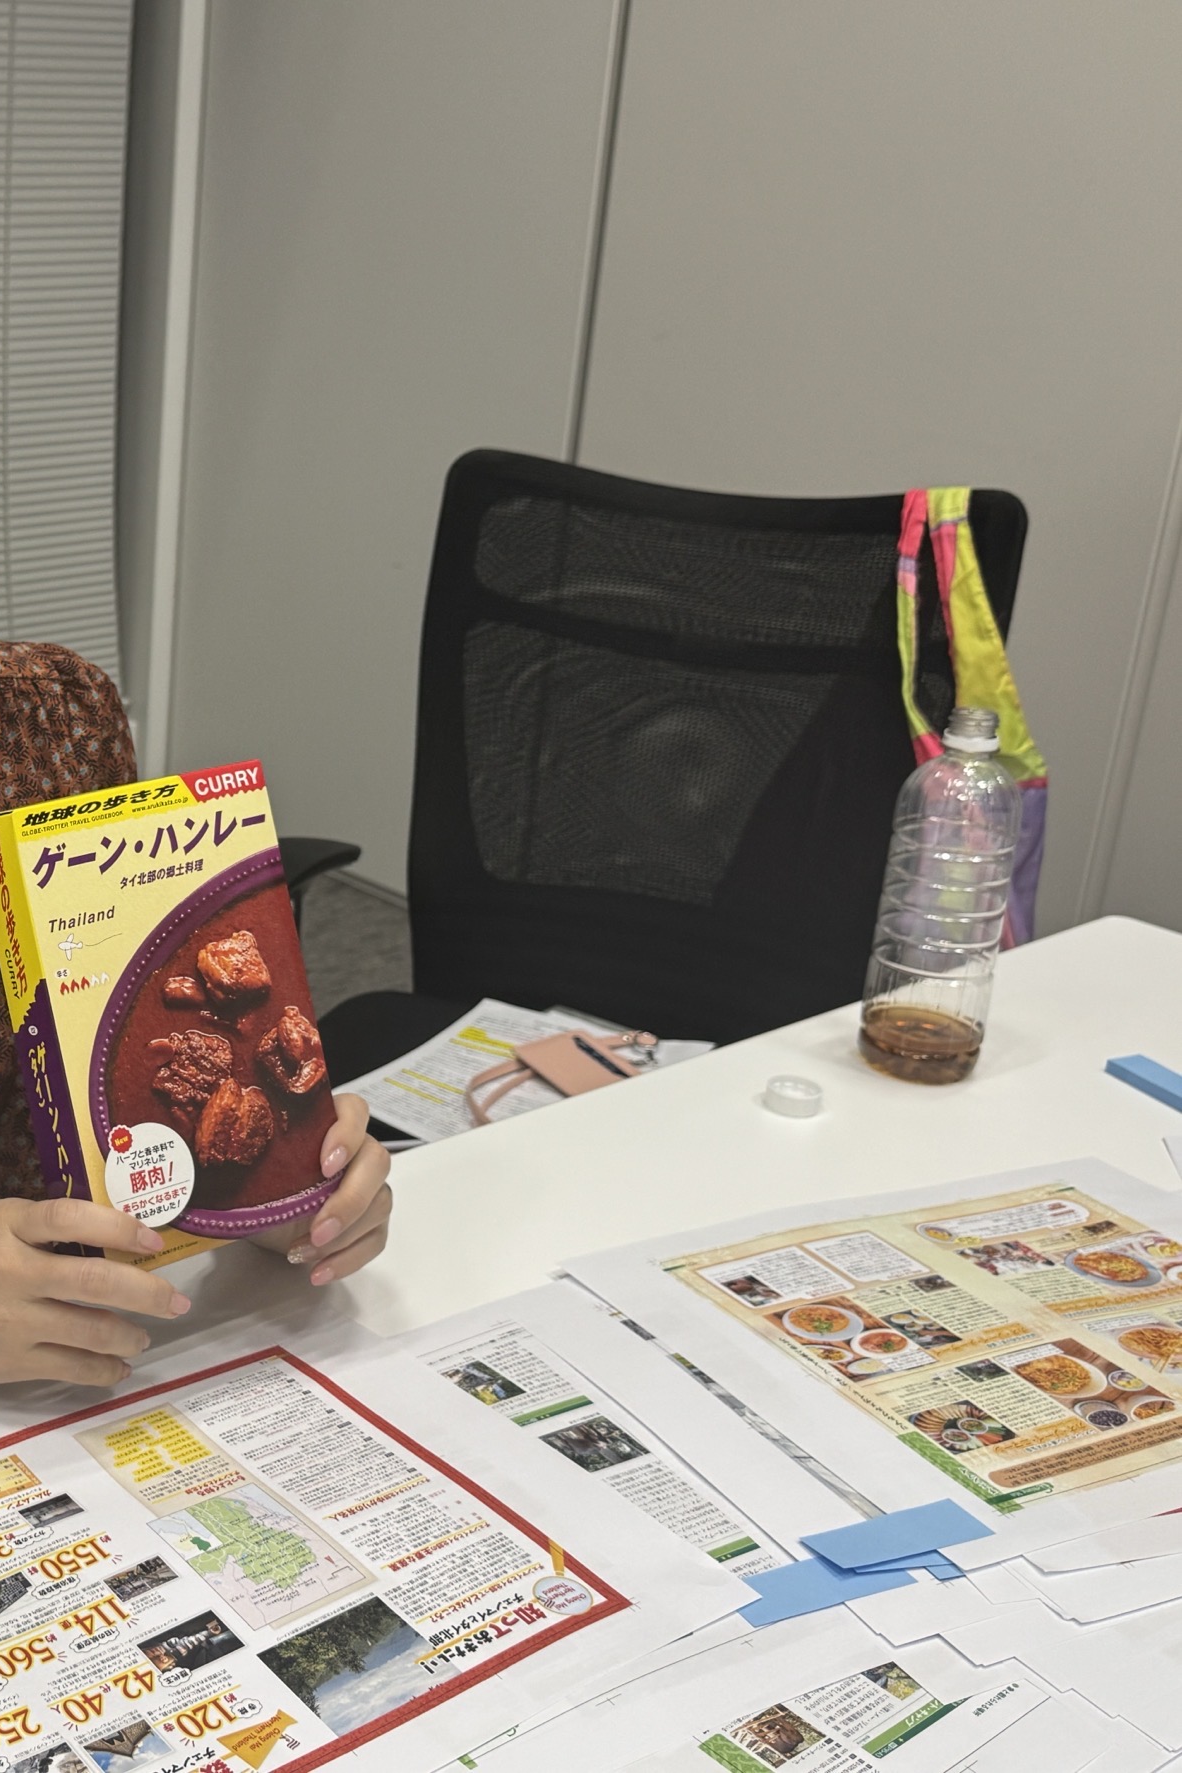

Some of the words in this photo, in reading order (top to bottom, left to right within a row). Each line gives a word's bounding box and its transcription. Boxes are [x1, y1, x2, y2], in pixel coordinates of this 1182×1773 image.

[193, 767, 280, 797] CURRY
[19, 782, 181, 828] 地球の歩き方
[131, 795, 188, 813] www.arukikata.co.jp
[20, 821, 69, 837] GLOBE-TROTTER
[69, 816, 90, 826] TRAVEL
[90, 809, 124, 822] GUIDEBOOK
[31, 809, 267, 890] ゲーン・ハンレー
[117, 858, 205, 890] タイ北部の郷土料理
[49, 905, 115, 928] Thailand
[5, 948, 21, 999] CURRY
[36, 1041, 72, 1198] ゲーン・ハン
[114, 1136, 128, 1146] New
[116, 1140, 175, 1165] ハーブと香辛料で
[129, 1154, 166, 1170] マリネした
[122, 1187, 188, 1214] 柔らかくなるまで
[3, 1489, 53, 1511] カム・ムアン
[11, 1529, 47, 1546] カフェの数
[35, 1575, 78, 1596] 宿泊施設数
[424, 1591, 527, 1646] チェンマイとタイ北部
[72, 1627, 117, 1650] 1日の航空便
[161, 1668, 190, 1685] 歴代王
[235, 1700, 258, 1716] 寺院
[253, 1714, 281, 1735] Northern
[259, 1727, 281, 1742] Chiang
[231, 1730, 257, 1752] Thailand
[250, 1737, 263, 1751] Mai
[155, 1747, 216, 1773] チェンマイ
